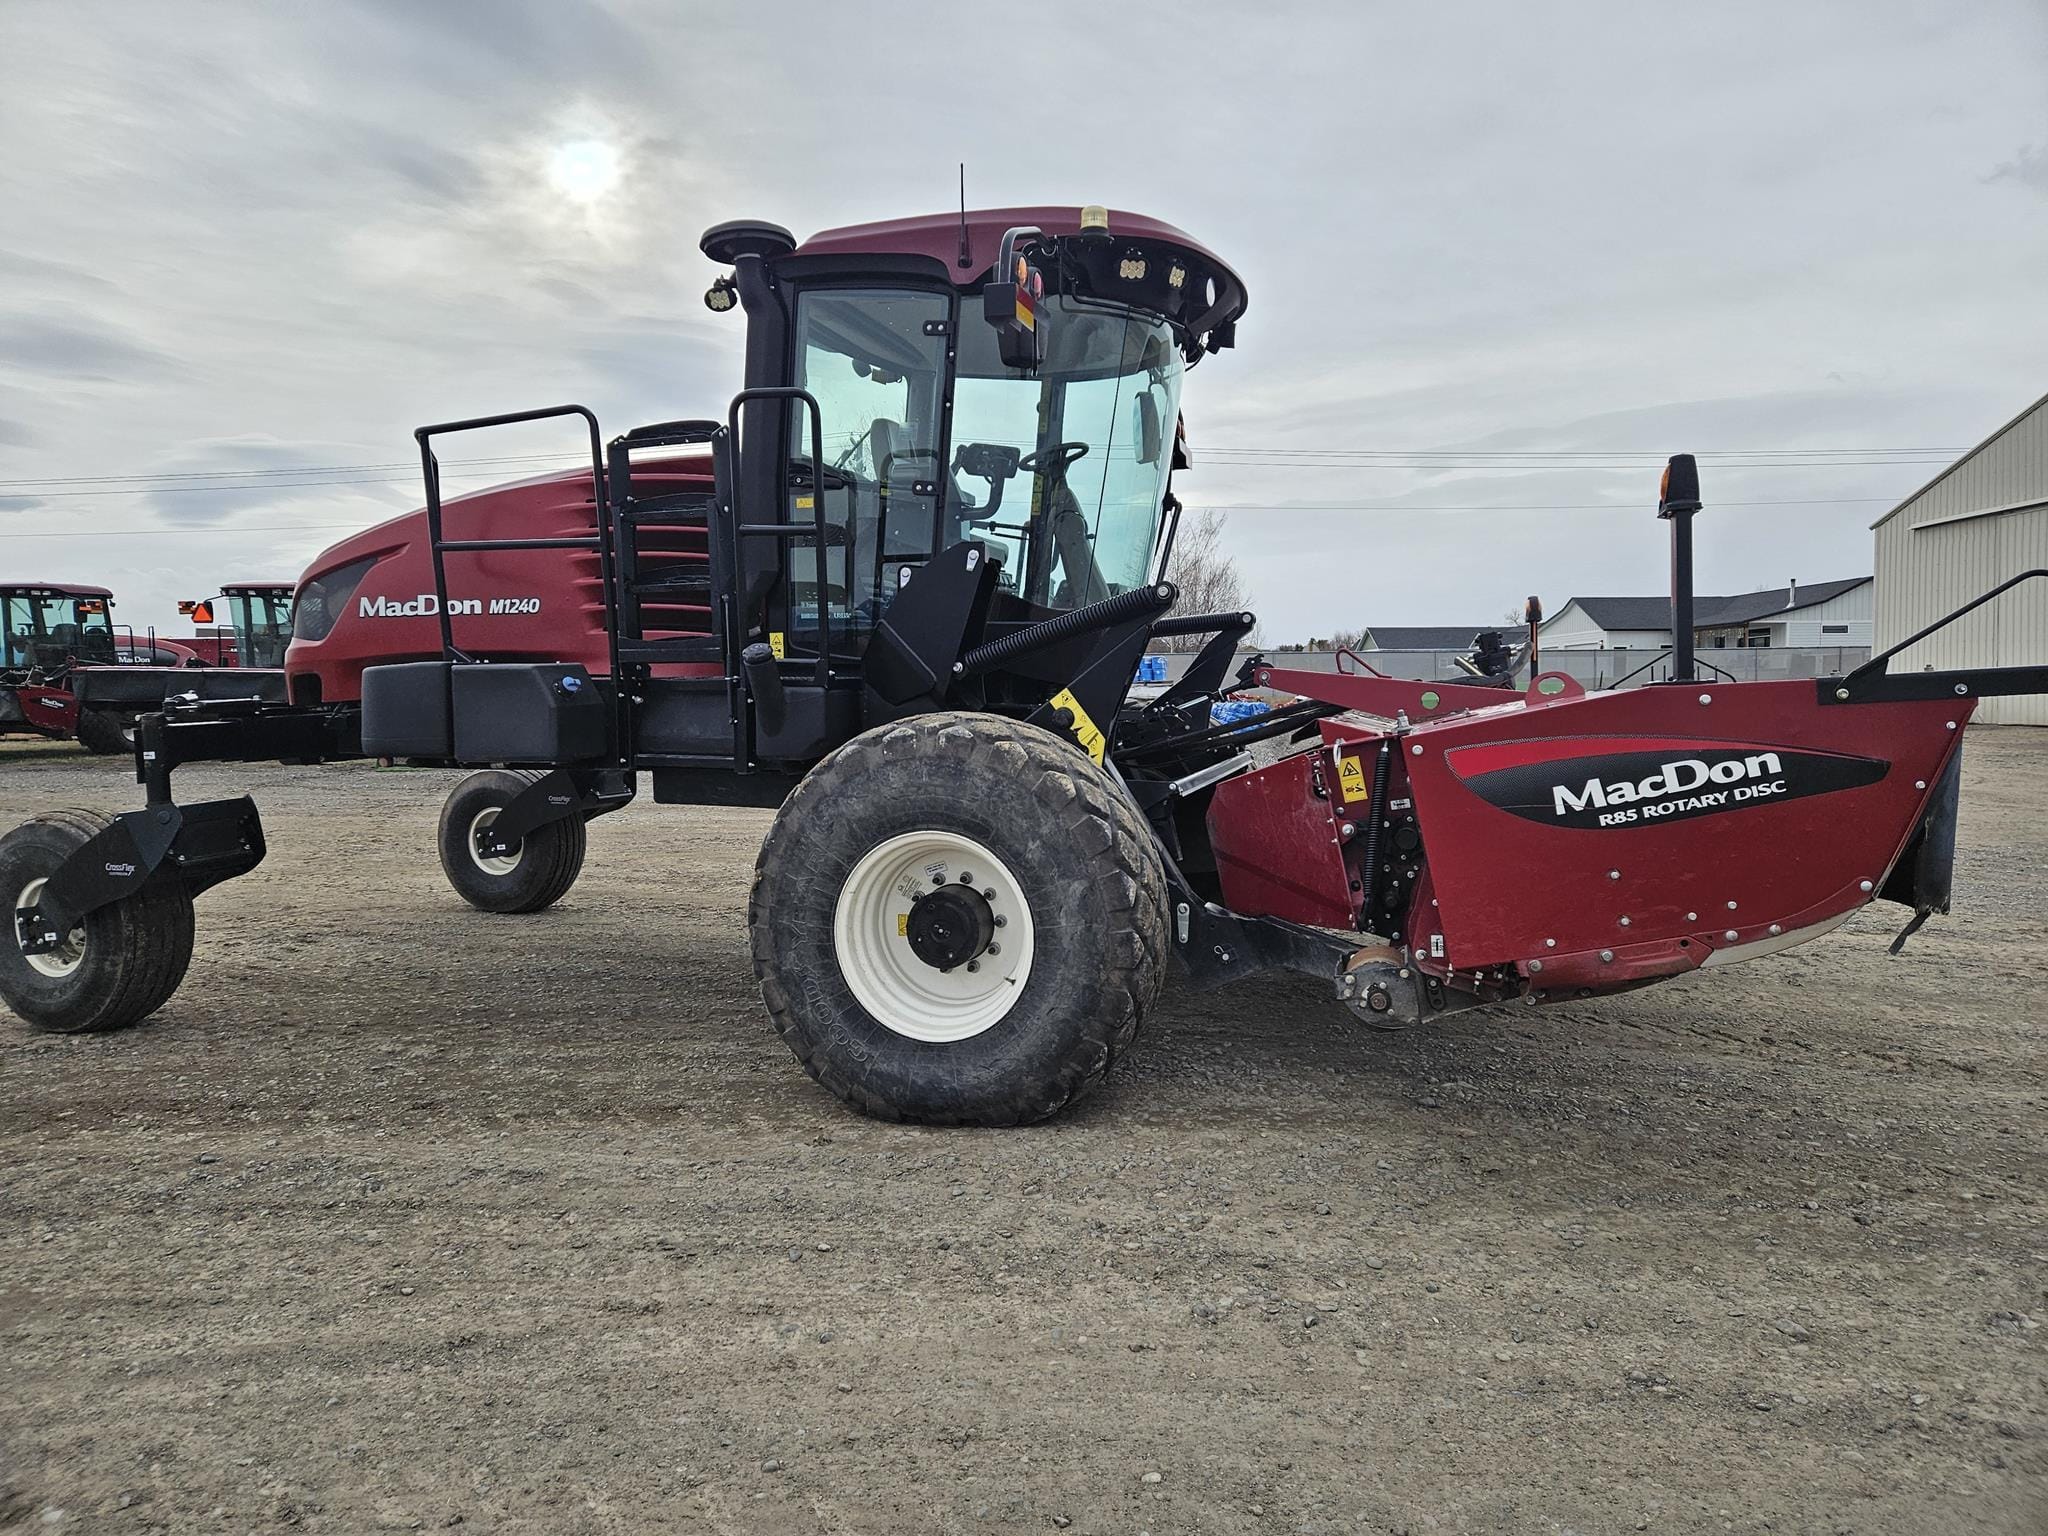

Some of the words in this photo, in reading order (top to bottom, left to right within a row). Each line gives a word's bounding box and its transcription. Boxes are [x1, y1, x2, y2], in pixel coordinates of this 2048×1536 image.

[359, 594, 482, 617] MacDon
[488, 598, 540, 614] M1240
[1552, 752, 1782, 816] MacDon
[1598, 808, 1639, 827] R85
[1643, 790, 1729, 818] ROTARY
[1733, 780, 1788, 802] DISC
